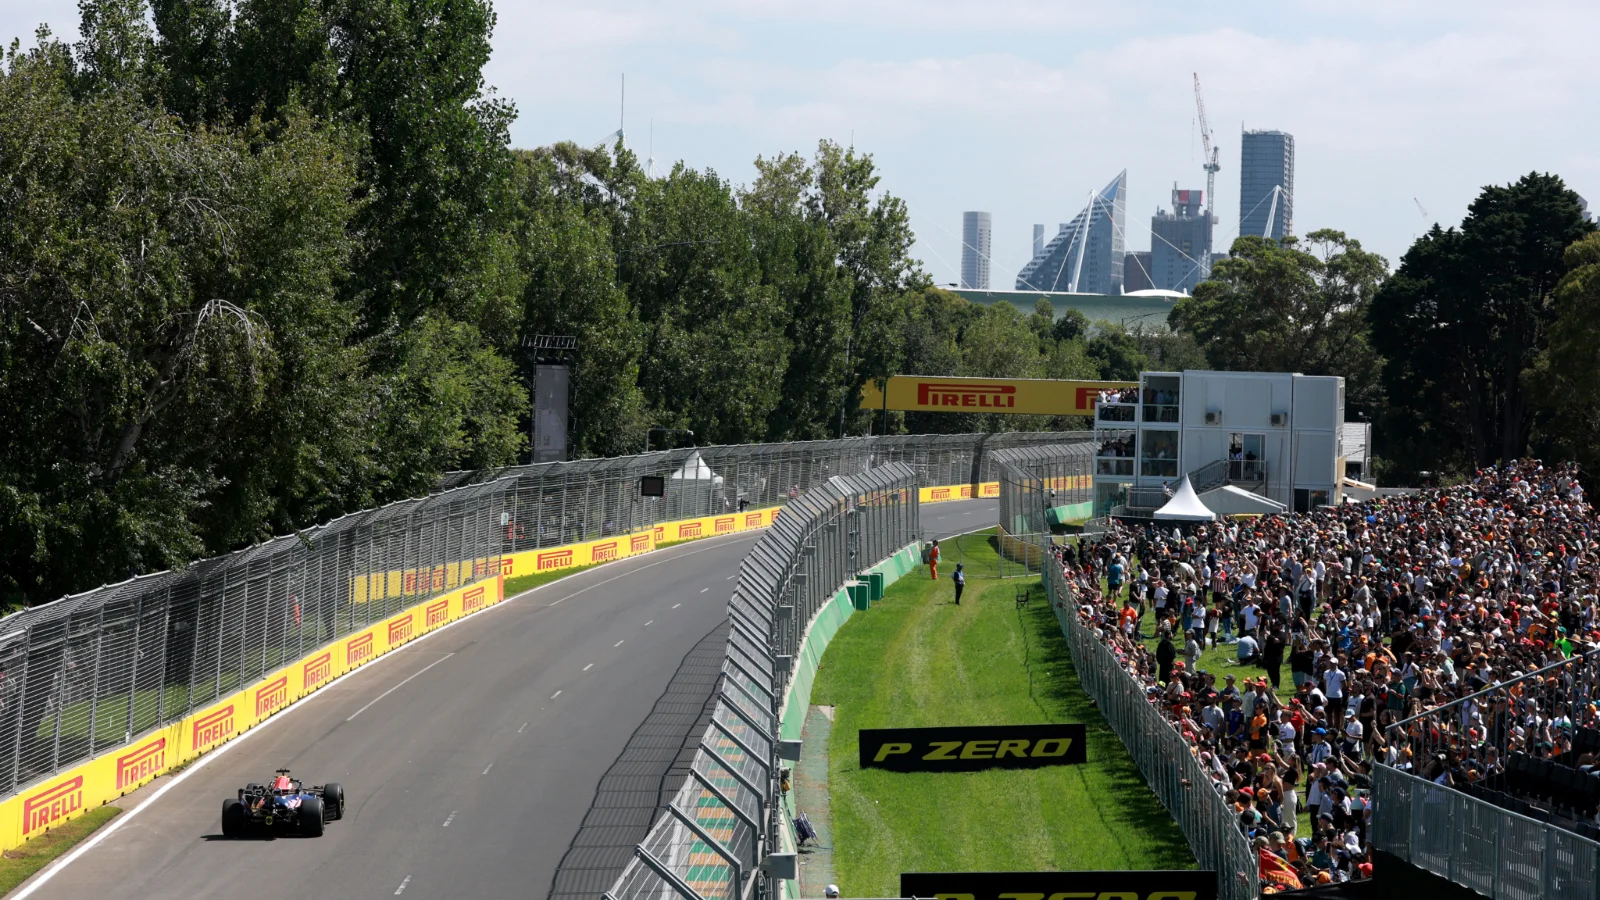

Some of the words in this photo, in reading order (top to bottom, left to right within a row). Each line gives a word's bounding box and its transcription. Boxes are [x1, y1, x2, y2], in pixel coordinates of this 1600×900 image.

[918, 383, 1016, 407] PIRELLI
[931, 488, 951, 500] PIRELLI
[679, 522, 702, 538] PIRELLI
[714, 517, 735, 532] PIRELLI
[592, 541, 618, 561] PIRELLI
[631, 534, 650, 552] PIRELLI
[537, 549, 573, 570] PIRELLI
[462, 586, 485, 612] PIRELLI
[426, 599, 448, 627] PIRELLI
[388, 614, 413, 645] PIRELLI
[347, 632, 373, 665] PIRELLI
[304, 652, 331, 689] PIRELLI
[255, 676, 288, 717] PIRELLI
[192, 704, 235, 751] PIRELLI
[873, 743, 912, 762] P
[922, 738, 1072, 761] ZERO
[116, 737, 166, 790] PIRELLI
[22, 775, 84, 836] PIRELLI
